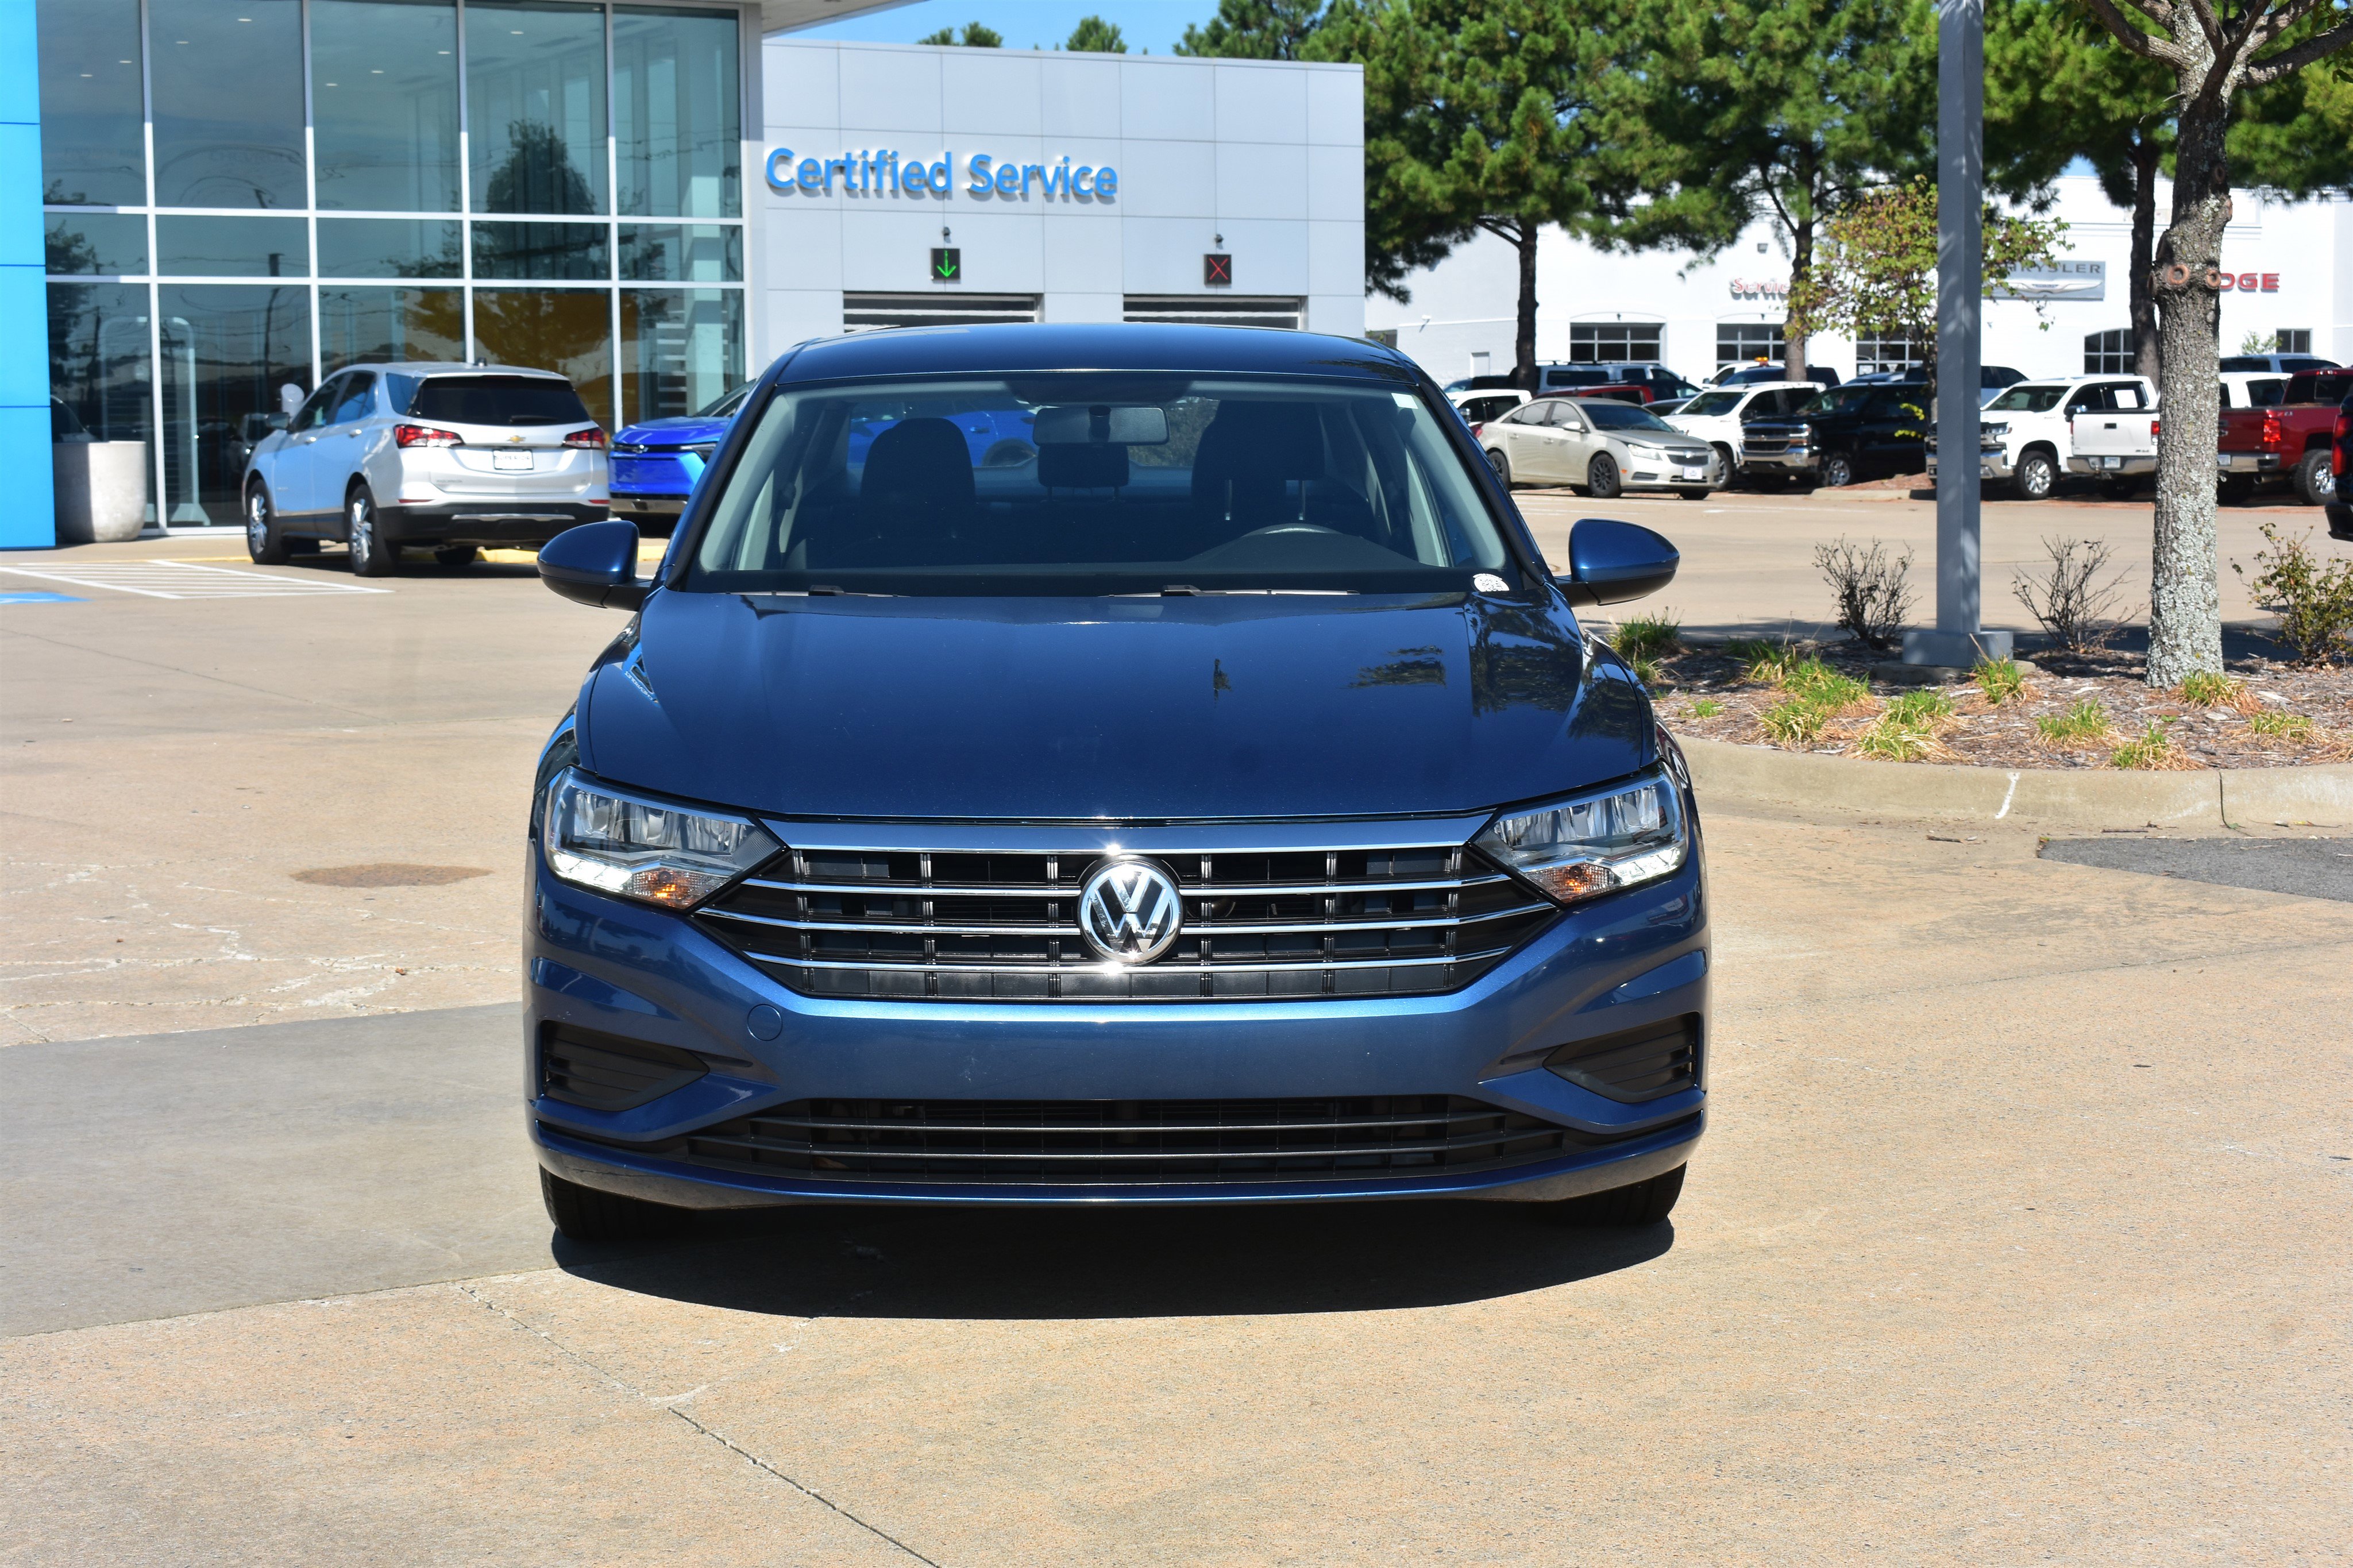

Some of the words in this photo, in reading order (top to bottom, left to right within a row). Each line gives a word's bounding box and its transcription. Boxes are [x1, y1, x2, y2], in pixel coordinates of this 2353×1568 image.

[766, 148, 952, 192] Certified
[969, 154, 1118, 196] Service
[2008, 262, 2101, 273] HRYSLER
[1732, 277, 1791, 293] Servic
[2220, 273, 2279, 289] DGE
